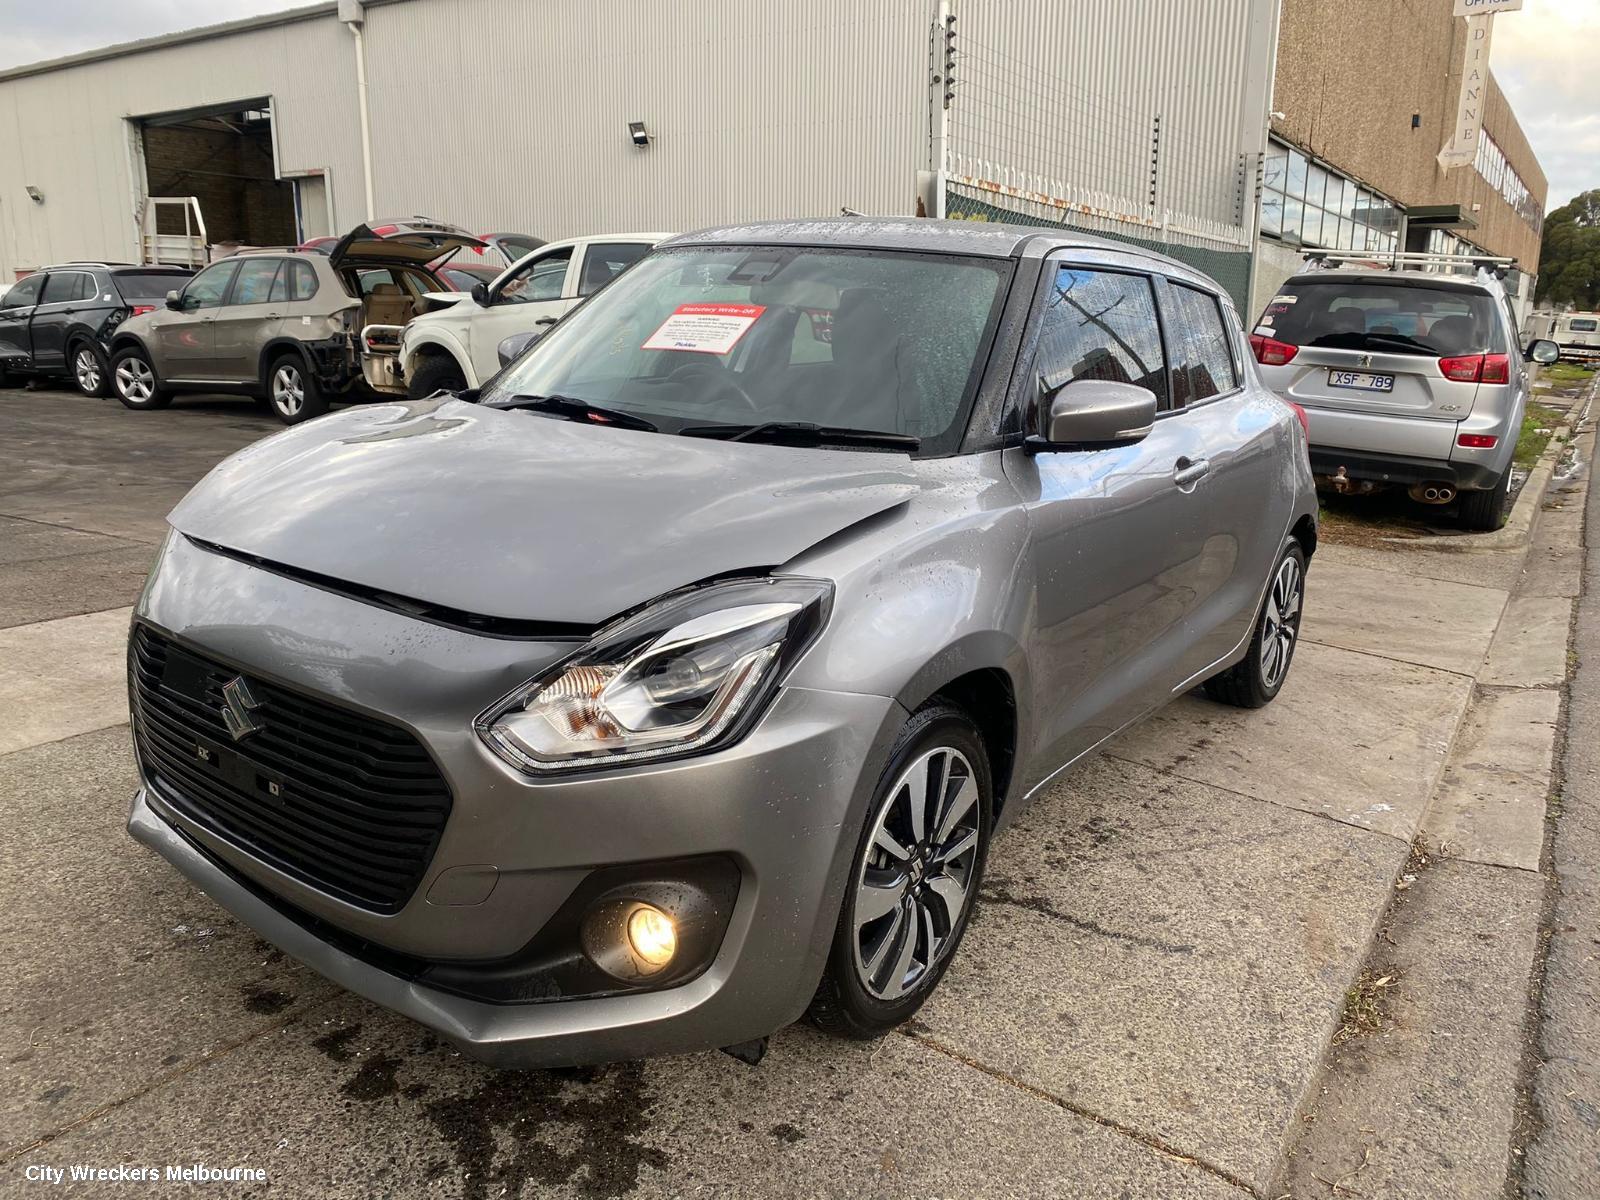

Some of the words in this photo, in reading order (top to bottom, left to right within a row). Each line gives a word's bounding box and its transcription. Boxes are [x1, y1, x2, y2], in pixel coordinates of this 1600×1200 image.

[1463, 28, 1485, 140] DIANNE
[718, 307, 756, 315] Write-Off
[1335, 372, 1360, 385] XSF
[1368, 376, 1392, 388] 789
